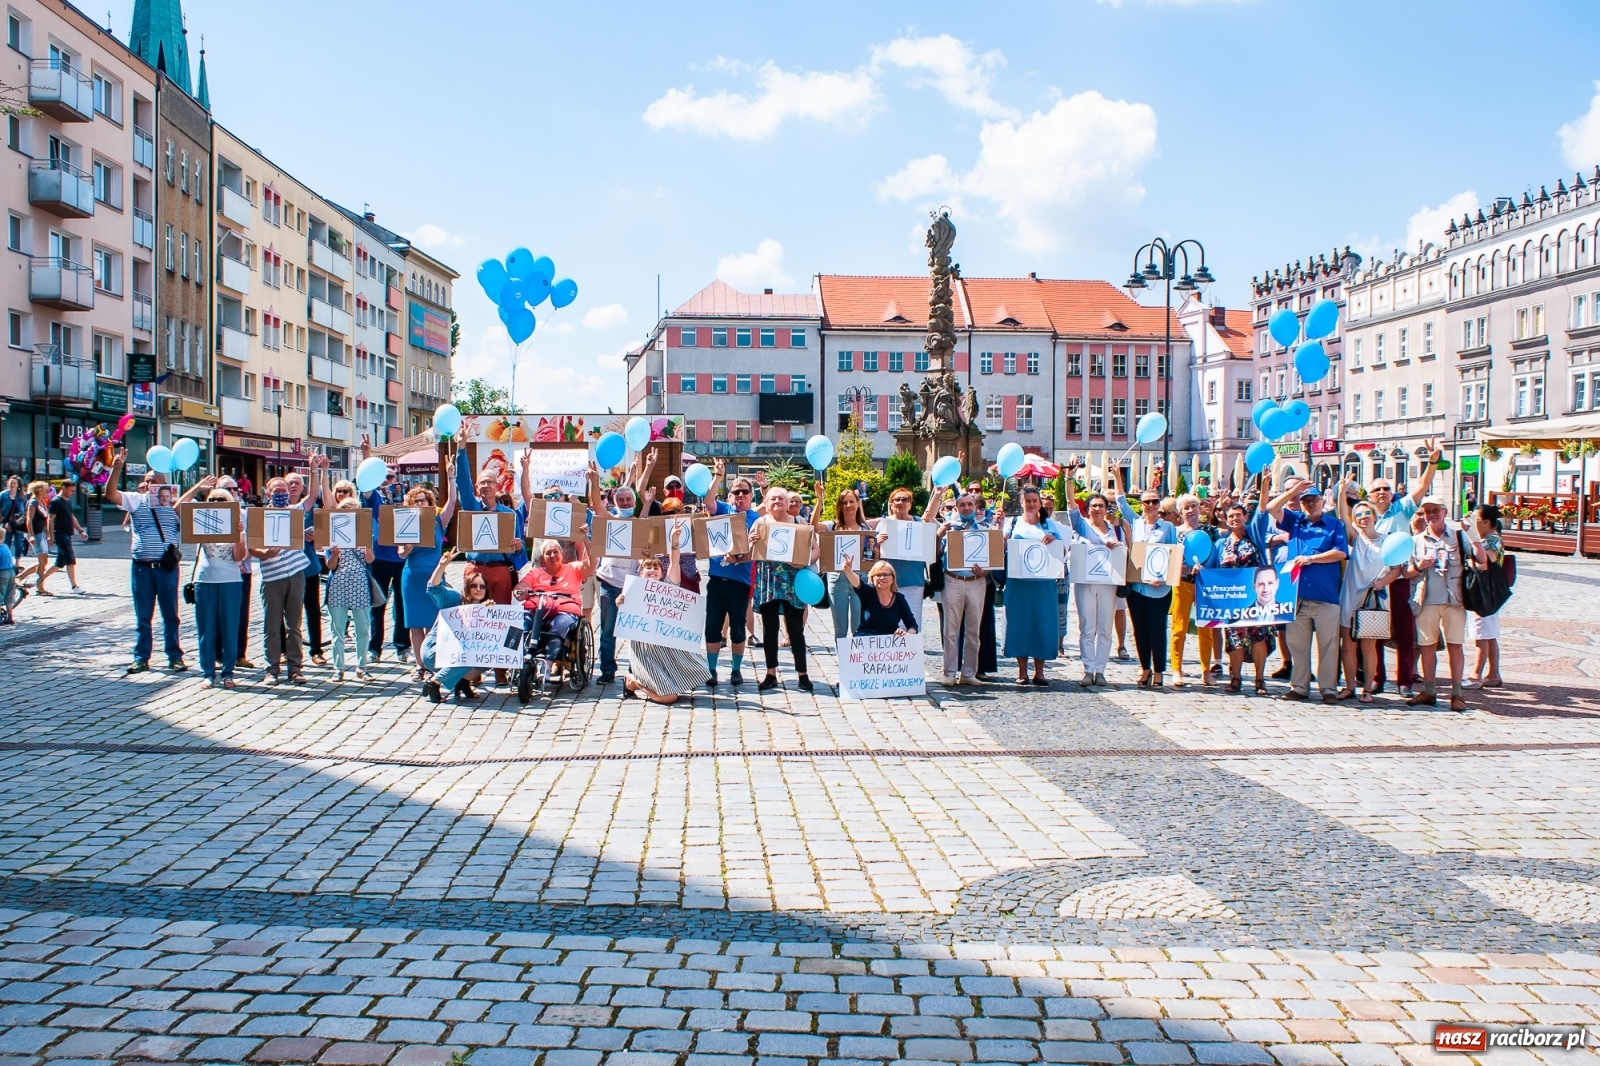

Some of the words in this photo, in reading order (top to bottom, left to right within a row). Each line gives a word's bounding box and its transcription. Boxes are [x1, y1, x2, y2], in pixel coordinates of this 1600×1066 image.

[127, 464, 145, 474] CASIO
[265, 513, 290, 542] T
[332, 515, 351, 543] R
[396, 509, 418, 538] Z
[474, 517, 497, 545] A
[548, 506, 570, 536] S
[606, 523, 627, 550] K
[669, 520, 690, 548] O
[707, 523, 729, 547] W
[769, 529, 789, 555] S
[836, 537, 856, 564] K
[964, 533, 988, 562] 2
[1088, 548, 1109, 576] 2
[644, 580, 696, 604] LEKARSTWEM
[644, 593, 656, 603] NA
[660, 597, 690, 612] NASZE
[487, 608, 523, 620] MARNEGO
[1200, 602, 1294, 619] TRZASKOWSKI
[454, 631, 501, 642] RACIBORZU
[618, 612, 649, 632] RAFAŁ
[655, 620, 702, 644] TRZASKOWSKI
[462, 641, 499, 652] RAFAŁA
[851, 638, 864, 650] NA
[870, 636, 906, 649] FILOKA
[450, 652, 467, 665] SIĘ
[850, 652, 864, 662] NIE
[868, 651, 917, 662] GŁOSUJEMY
[862, 663, 908, 674] RAFAŁOWI
[848, 679, 879, 689] DOBRZE
[882, 678, 924, 688] WINSZUJEMY
